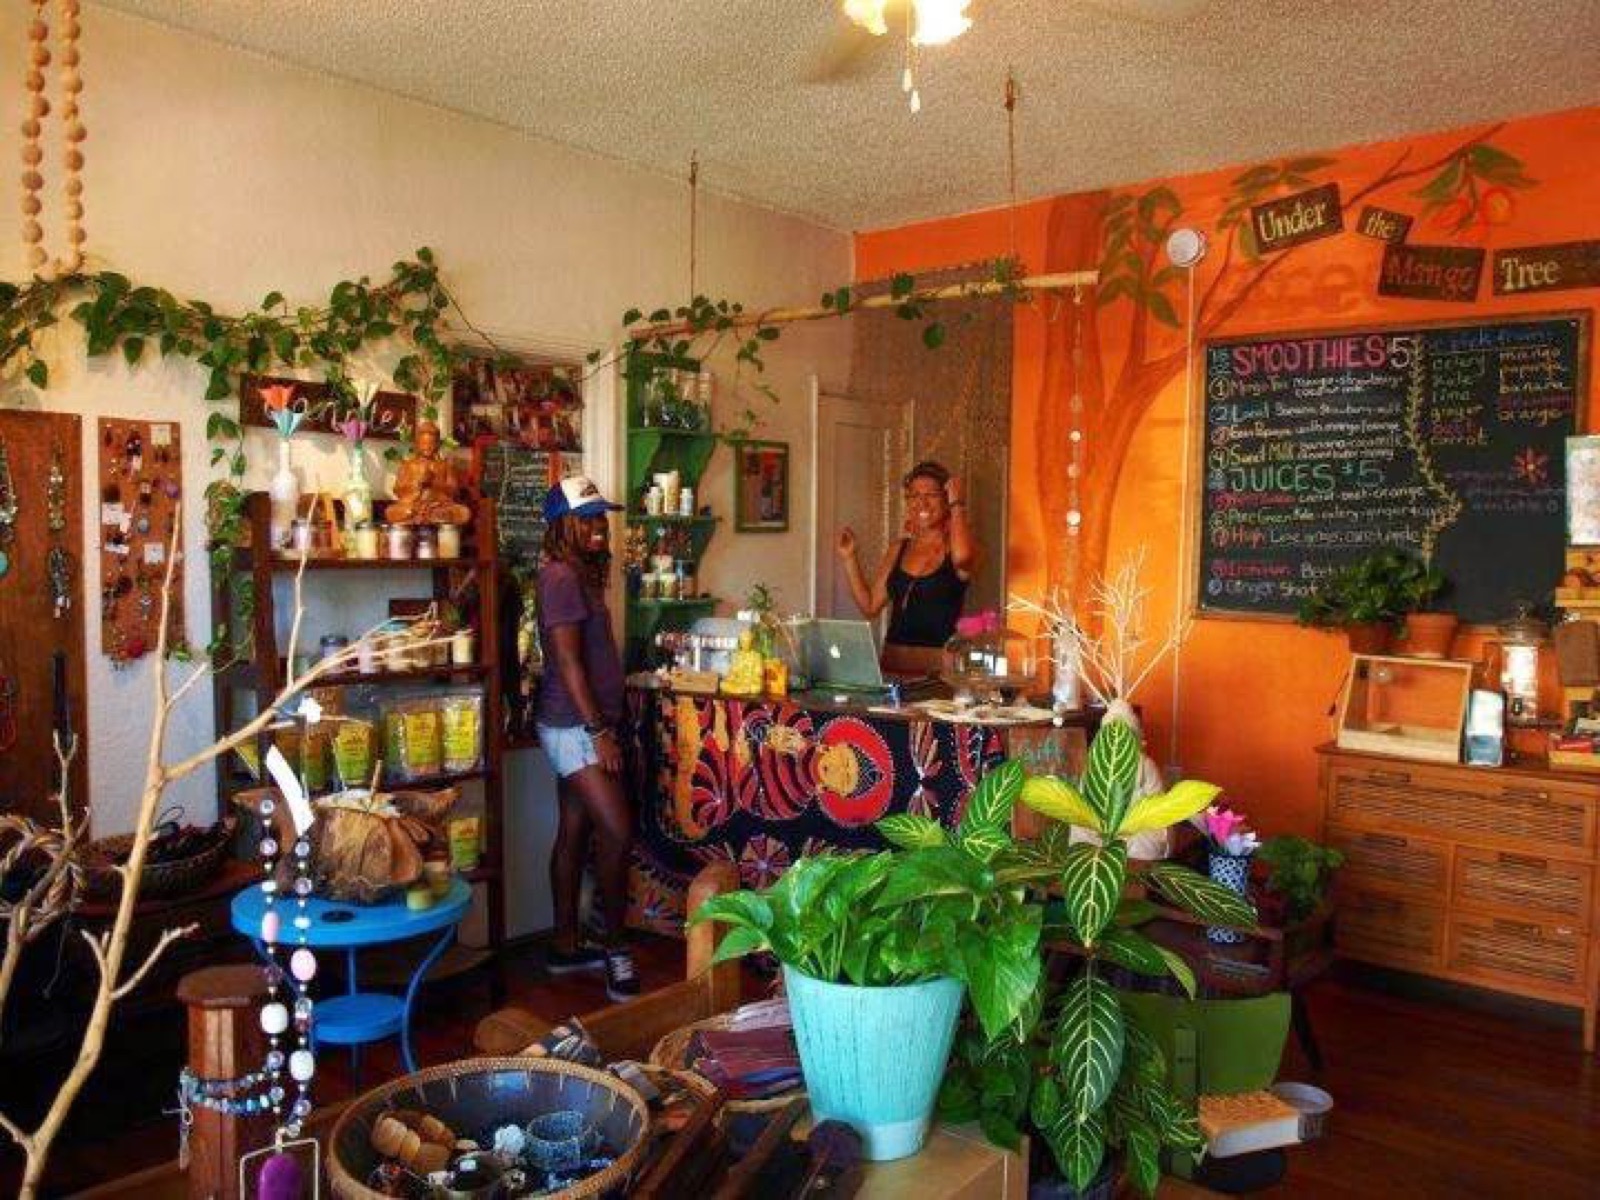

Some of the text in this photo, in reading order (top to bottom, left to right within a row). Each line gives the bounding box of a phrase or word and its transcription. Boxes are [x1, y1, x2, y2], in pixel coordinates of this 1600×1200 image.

[1259, 201, 1396, 242] Under the
[1501, 258, 1560, 291] Tree
[1232, 335, 1386, 376] SMOOTHIES
[1229, 463, 1336, 494] JUICES
